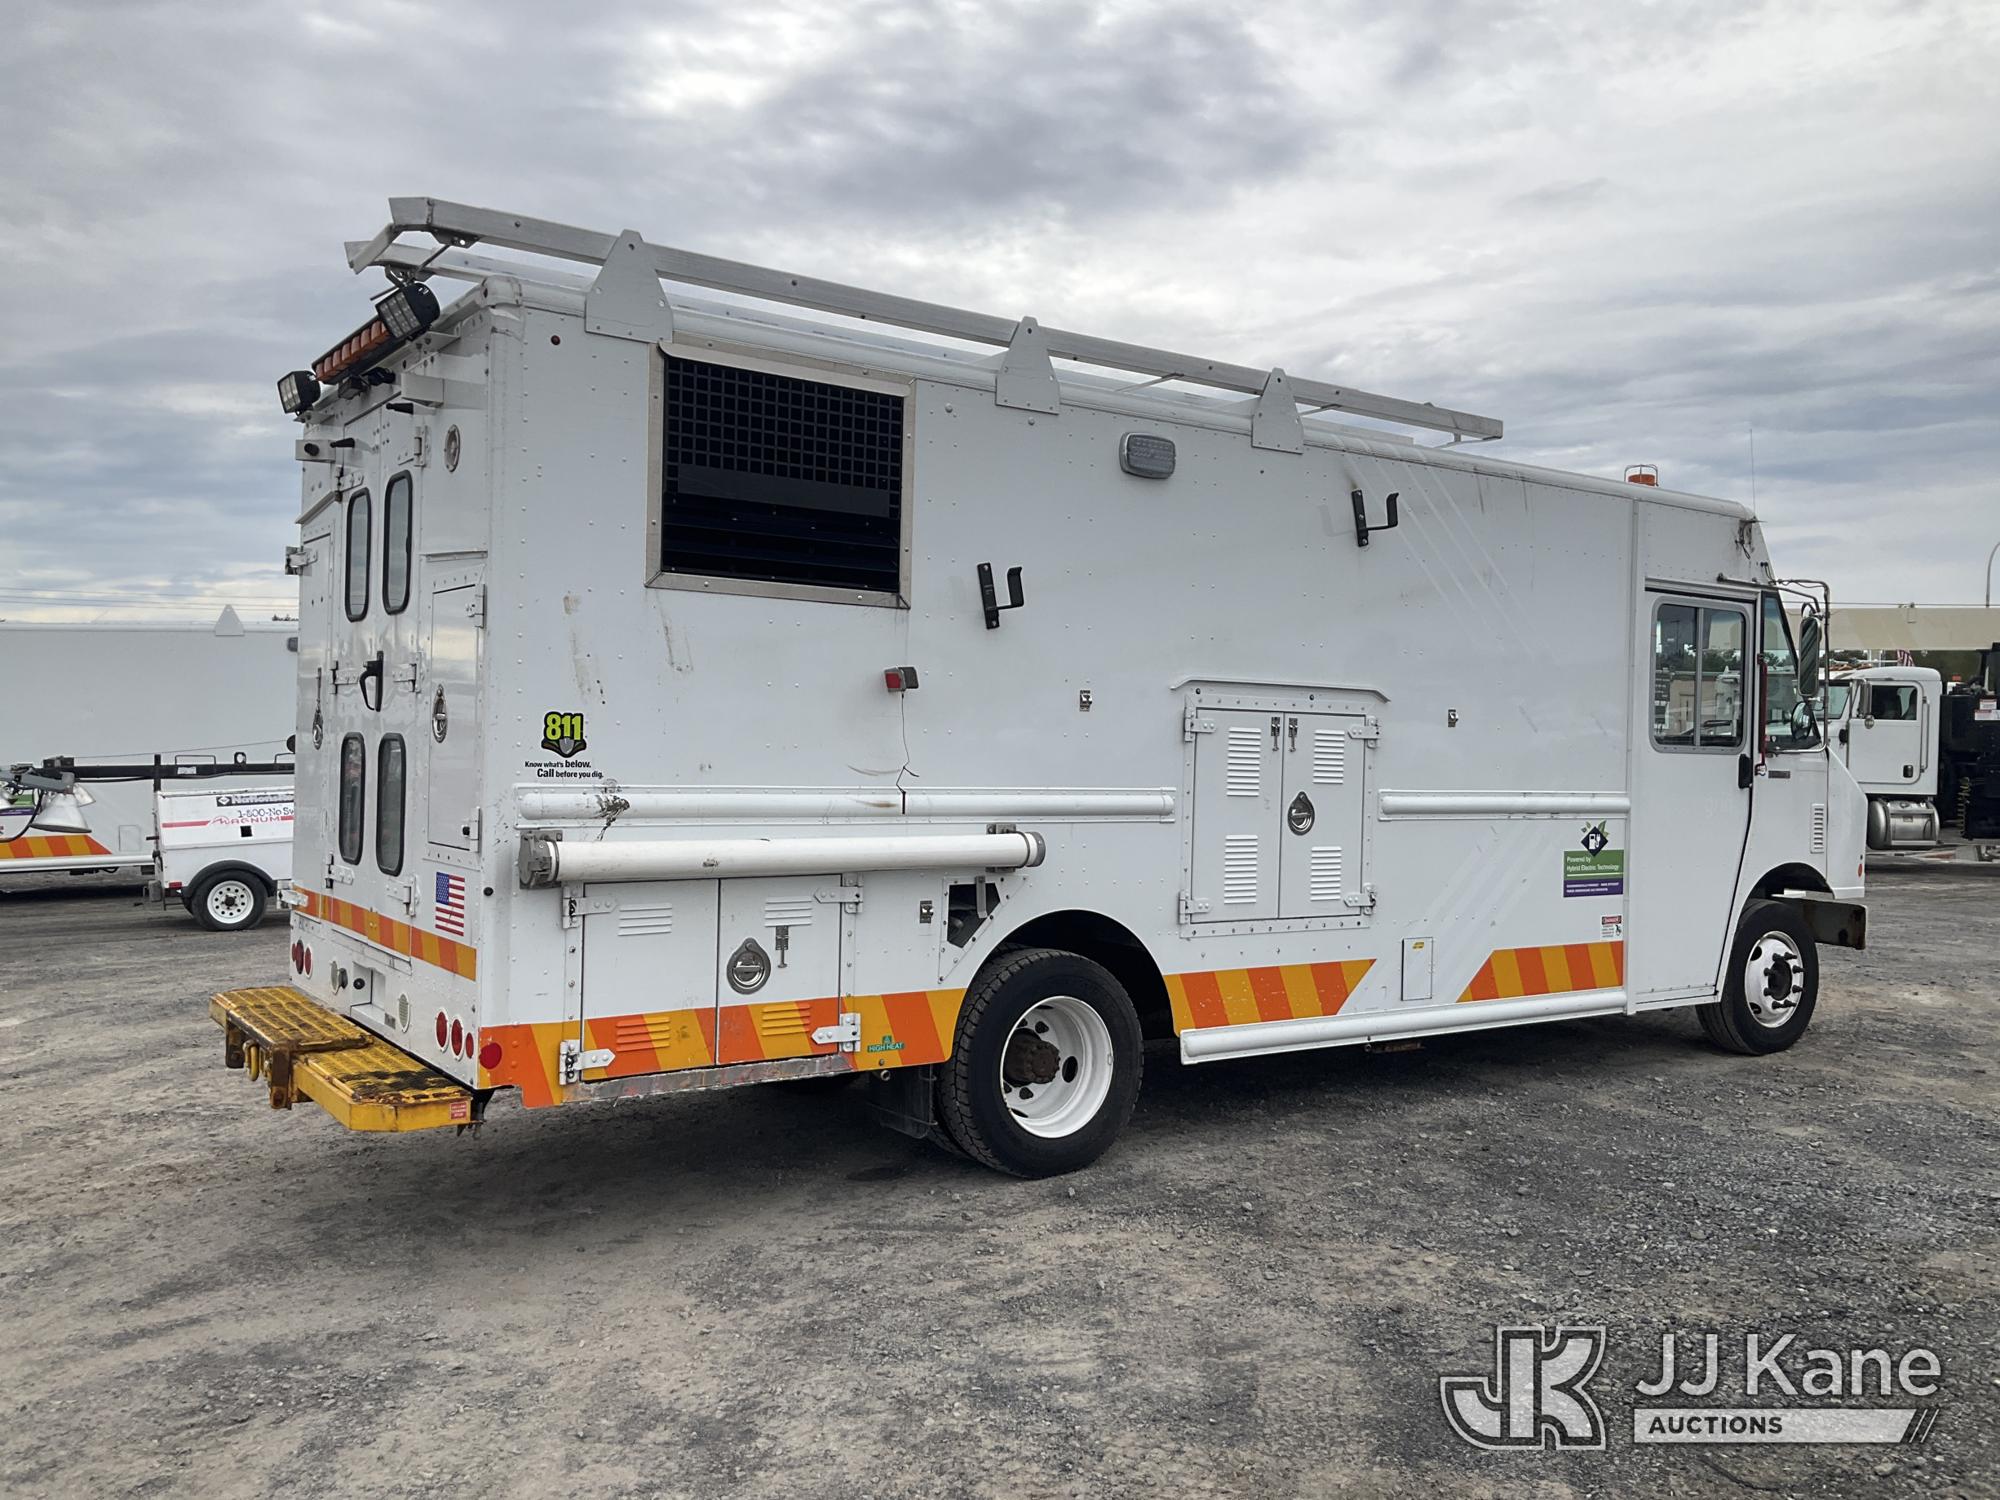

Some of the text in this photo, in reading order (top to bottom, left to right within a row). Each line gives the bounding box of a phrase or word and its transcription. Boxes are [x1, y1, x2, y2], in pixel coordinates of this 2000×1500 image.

[545, 713, 582, 741] 811
[565, 760, 592, 769] below.
[537, 768, 555, 778] Call
[555, 770, 578, 778] before
[591, 770, 604, 779] dig.
[1597, 863, 1619, 871] Technology
[886, 1042, 903, 1050] HEAT
